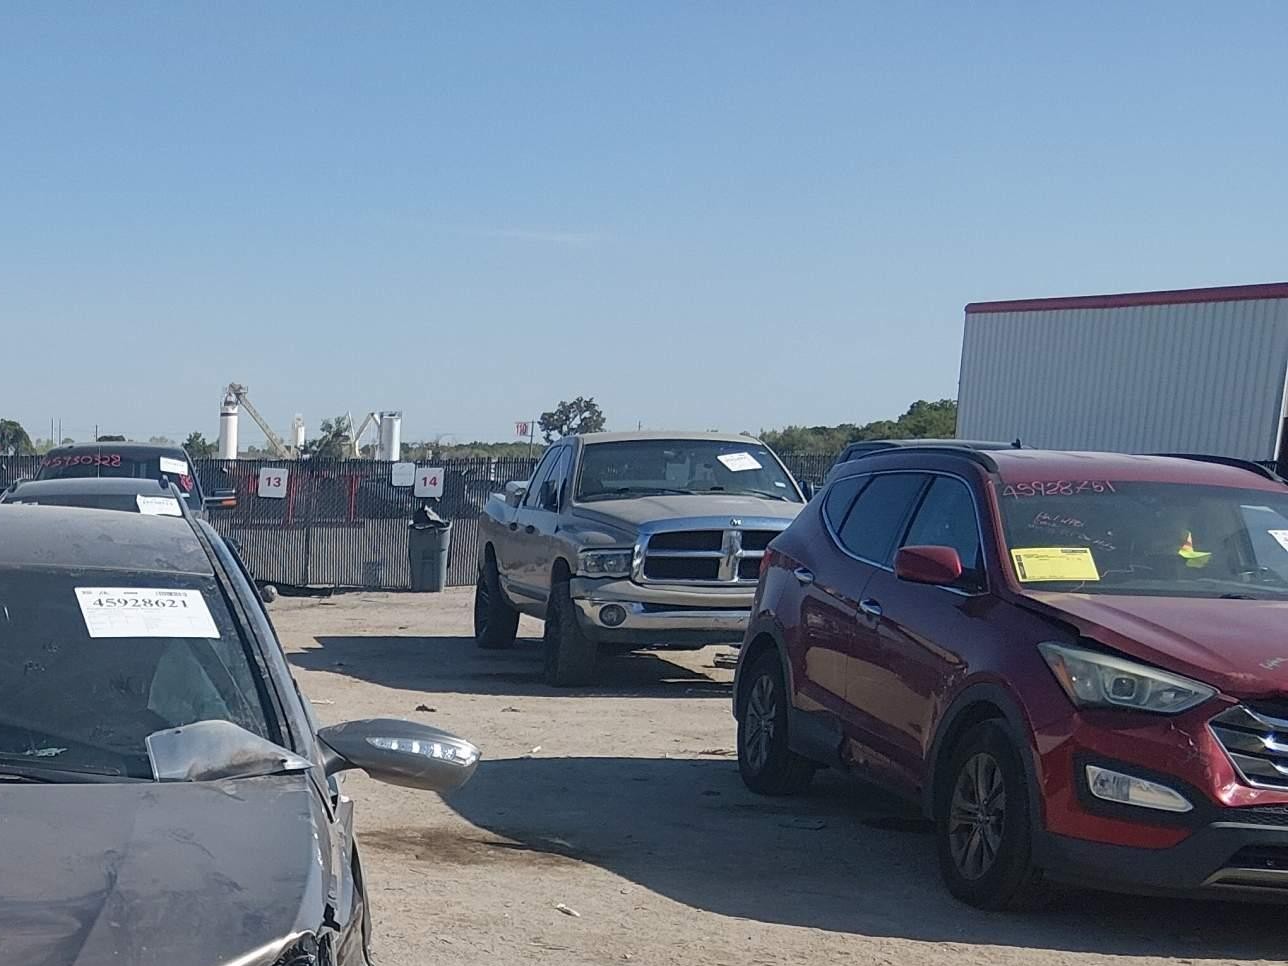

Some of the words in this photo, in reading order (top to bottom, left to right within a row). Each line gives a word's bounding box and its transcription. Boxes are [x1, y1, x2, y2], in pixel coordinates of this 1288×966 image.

[265, 476, 282, 488] 13
[422, 476, 438, 487] 14
[92, 597, 190, 609] 45928621
